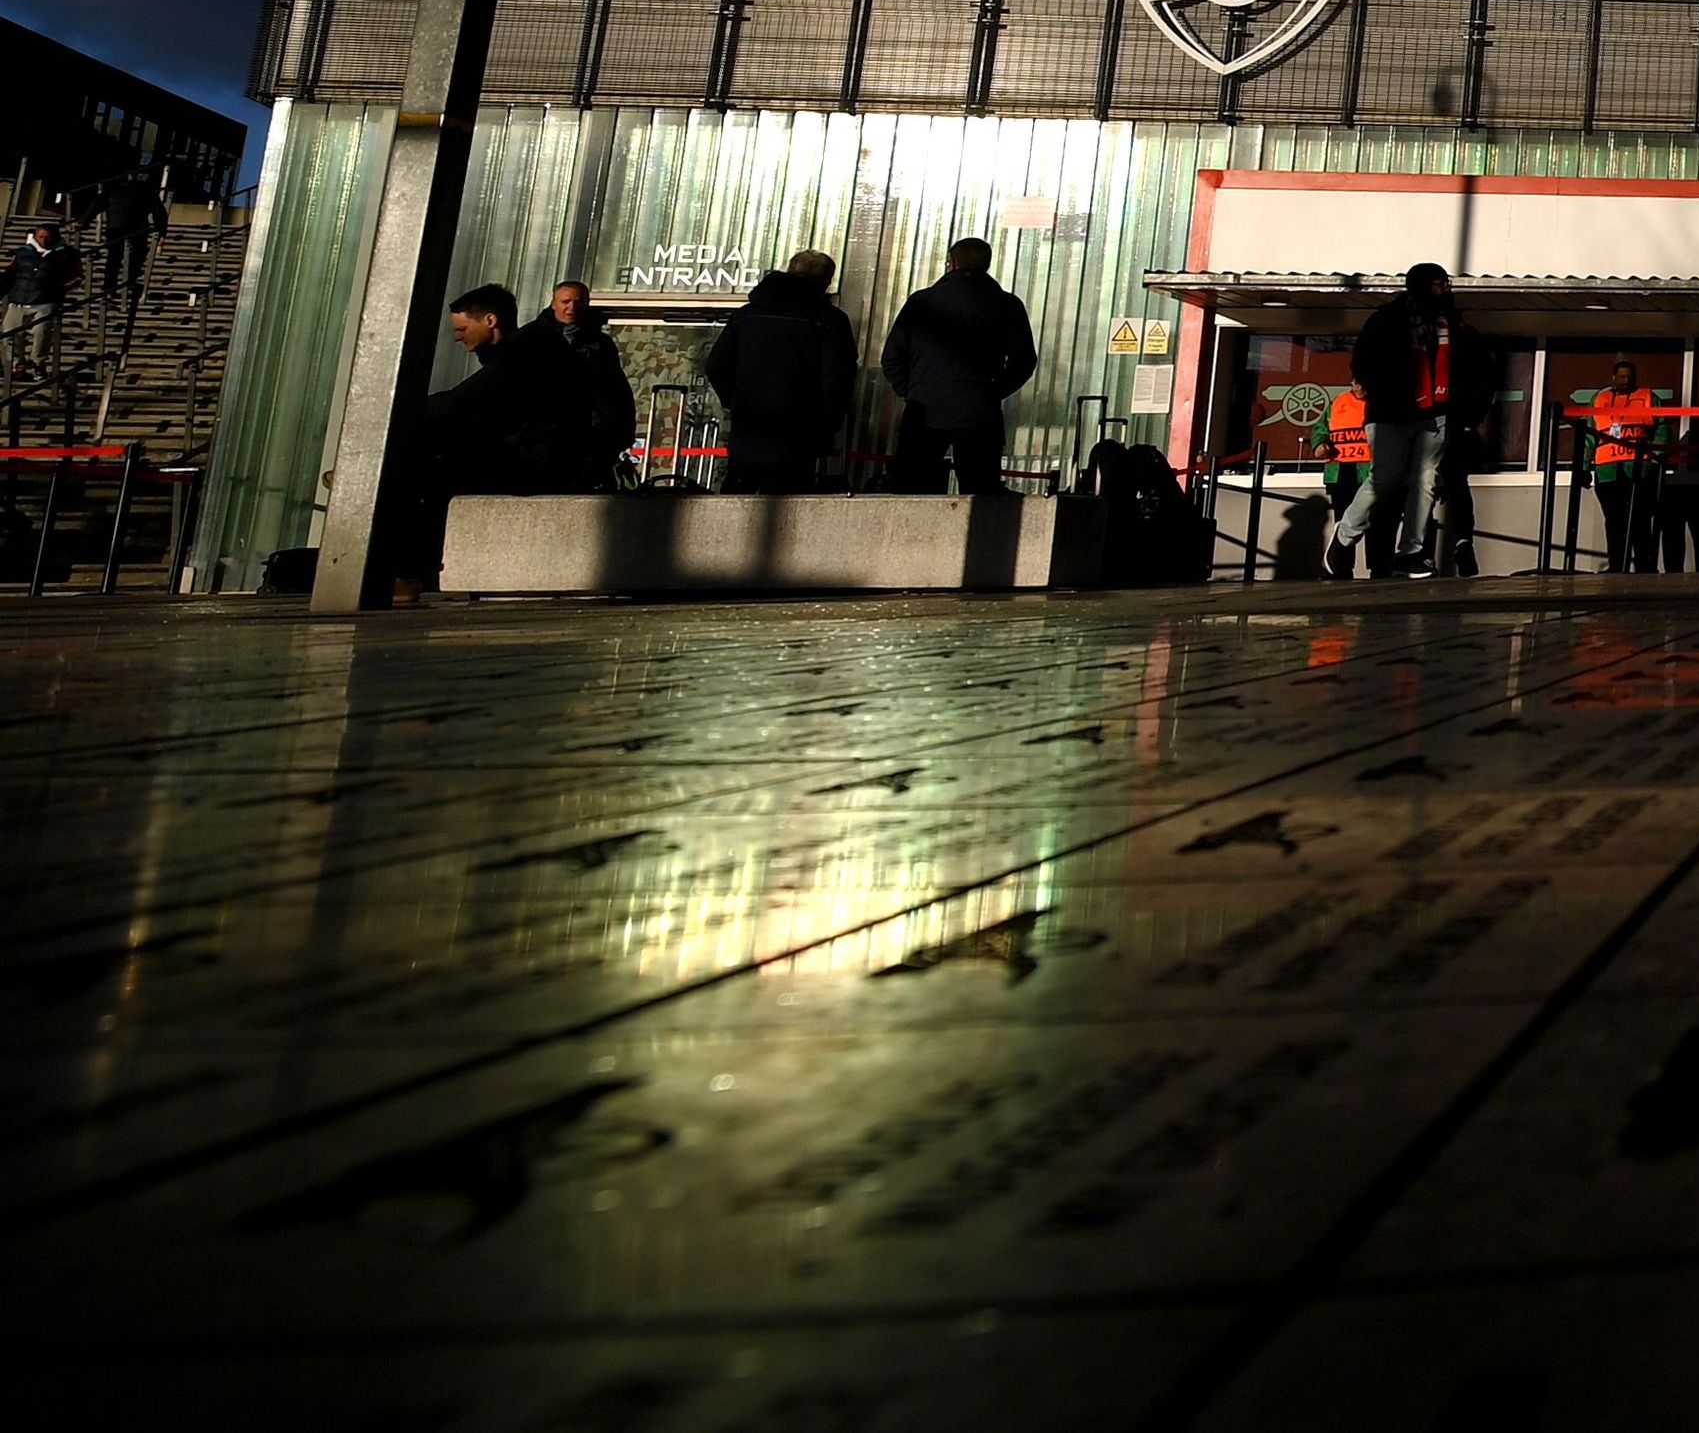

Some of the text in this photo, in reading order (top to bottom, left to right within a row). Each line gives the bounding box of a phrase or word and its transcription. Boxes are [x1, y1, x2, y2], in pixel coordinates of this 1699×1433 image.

[653, 243, 746, 265] MEDIA
[616, 266, 762, 286] ENTRANC
[1340, 446, 1365, 458] 124
